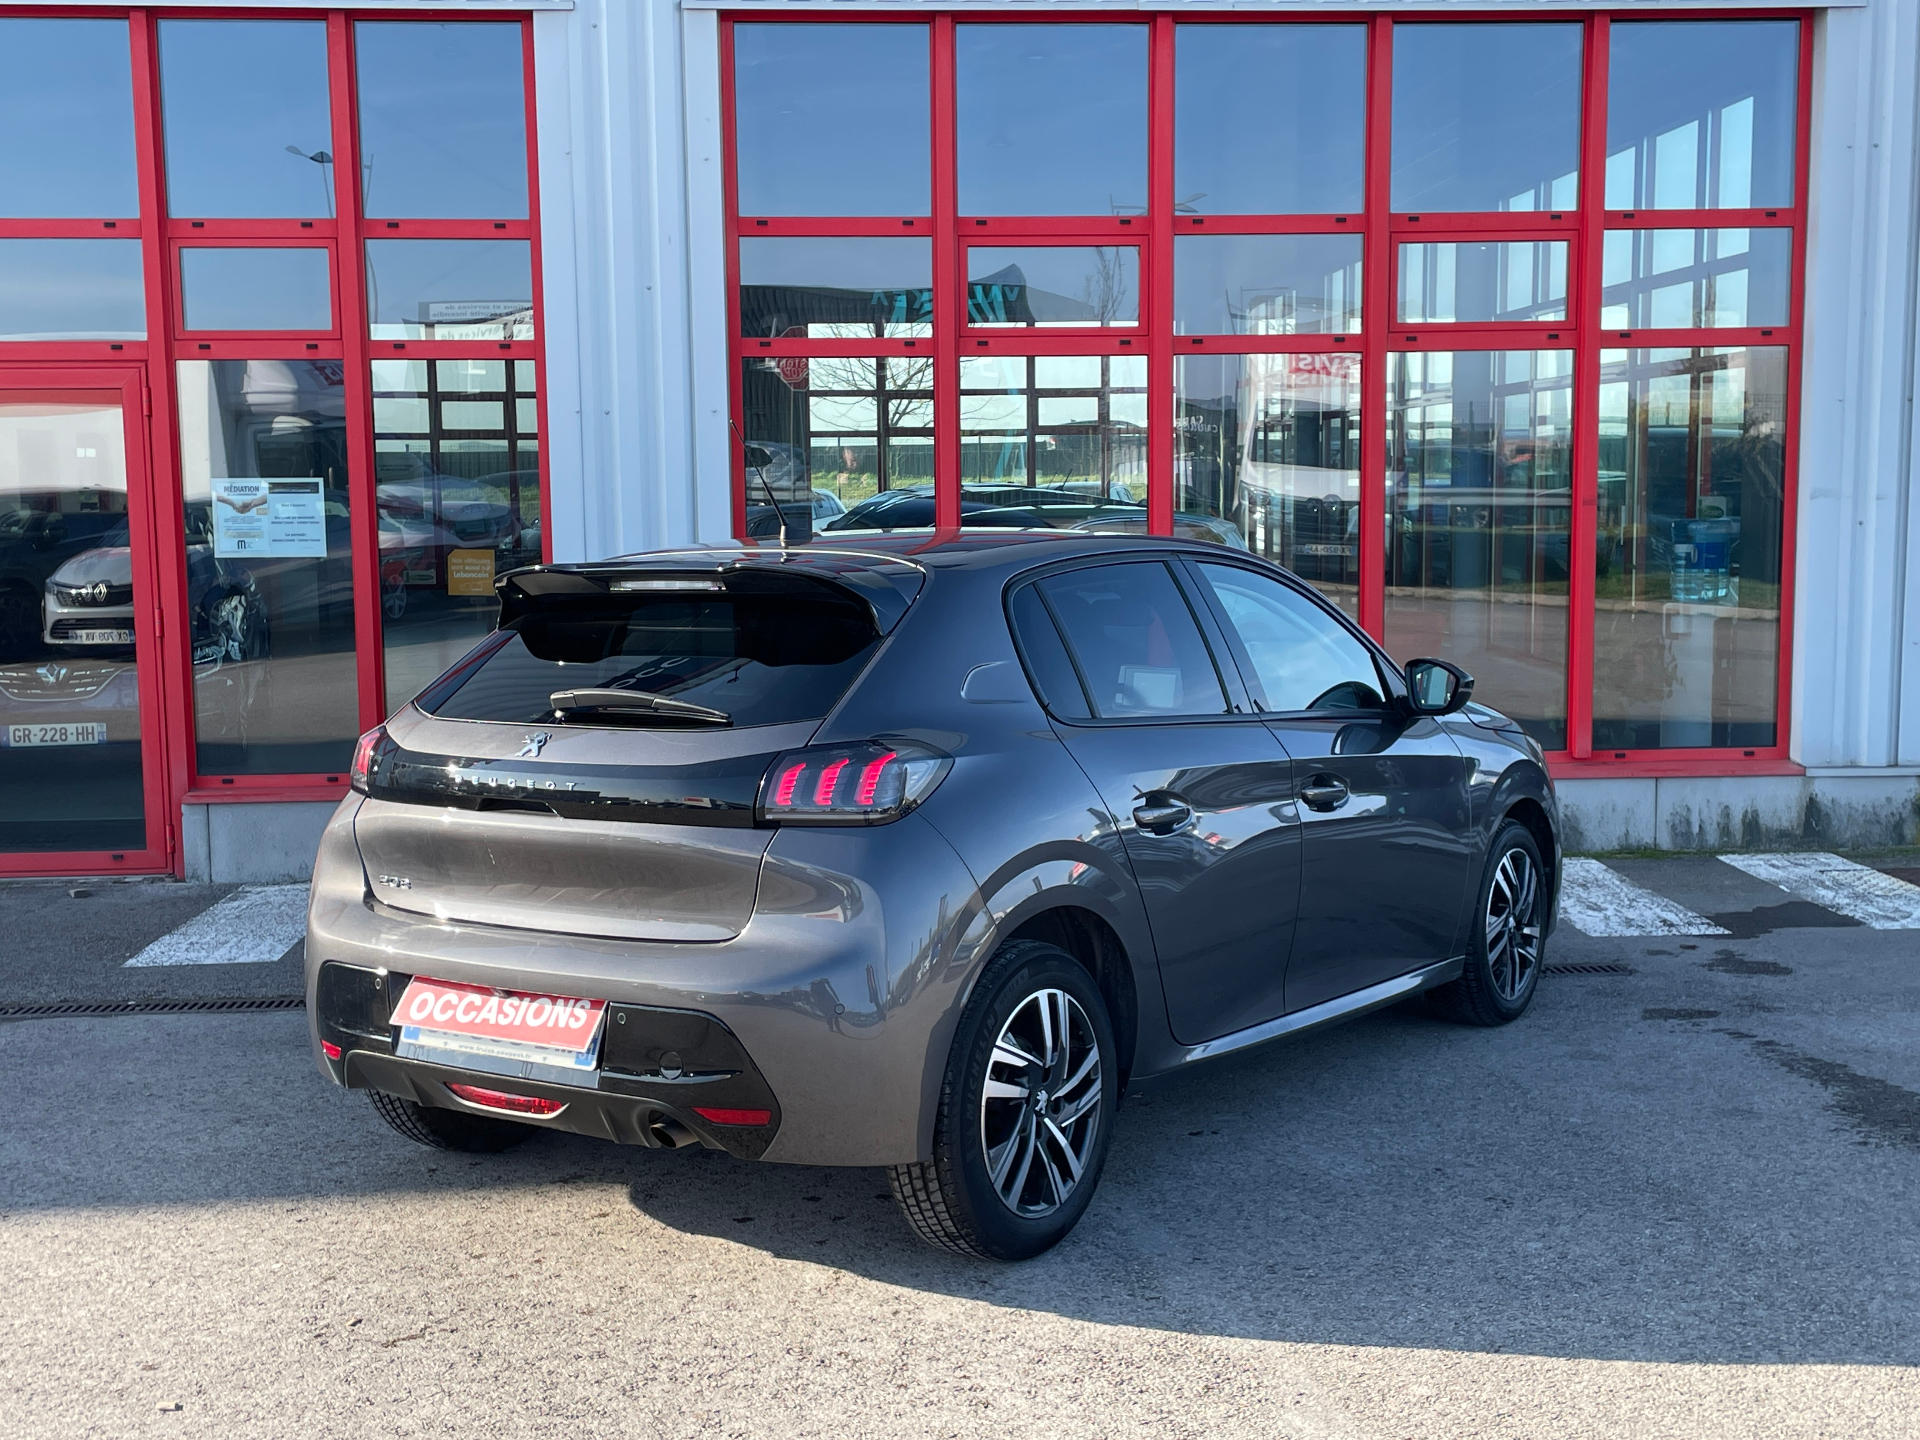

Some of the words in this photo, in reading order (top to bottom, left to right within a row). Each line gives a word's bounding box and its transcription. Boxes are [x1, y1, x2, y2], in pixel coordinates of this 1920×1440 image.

[224, 484, 260, 493] MÉDIATION
[12, 725, 95, 743] GR-228-HH
[455, 774, 575, 791] PEUGEOT
[408, 991, 592, 1029] OCCASIONS
